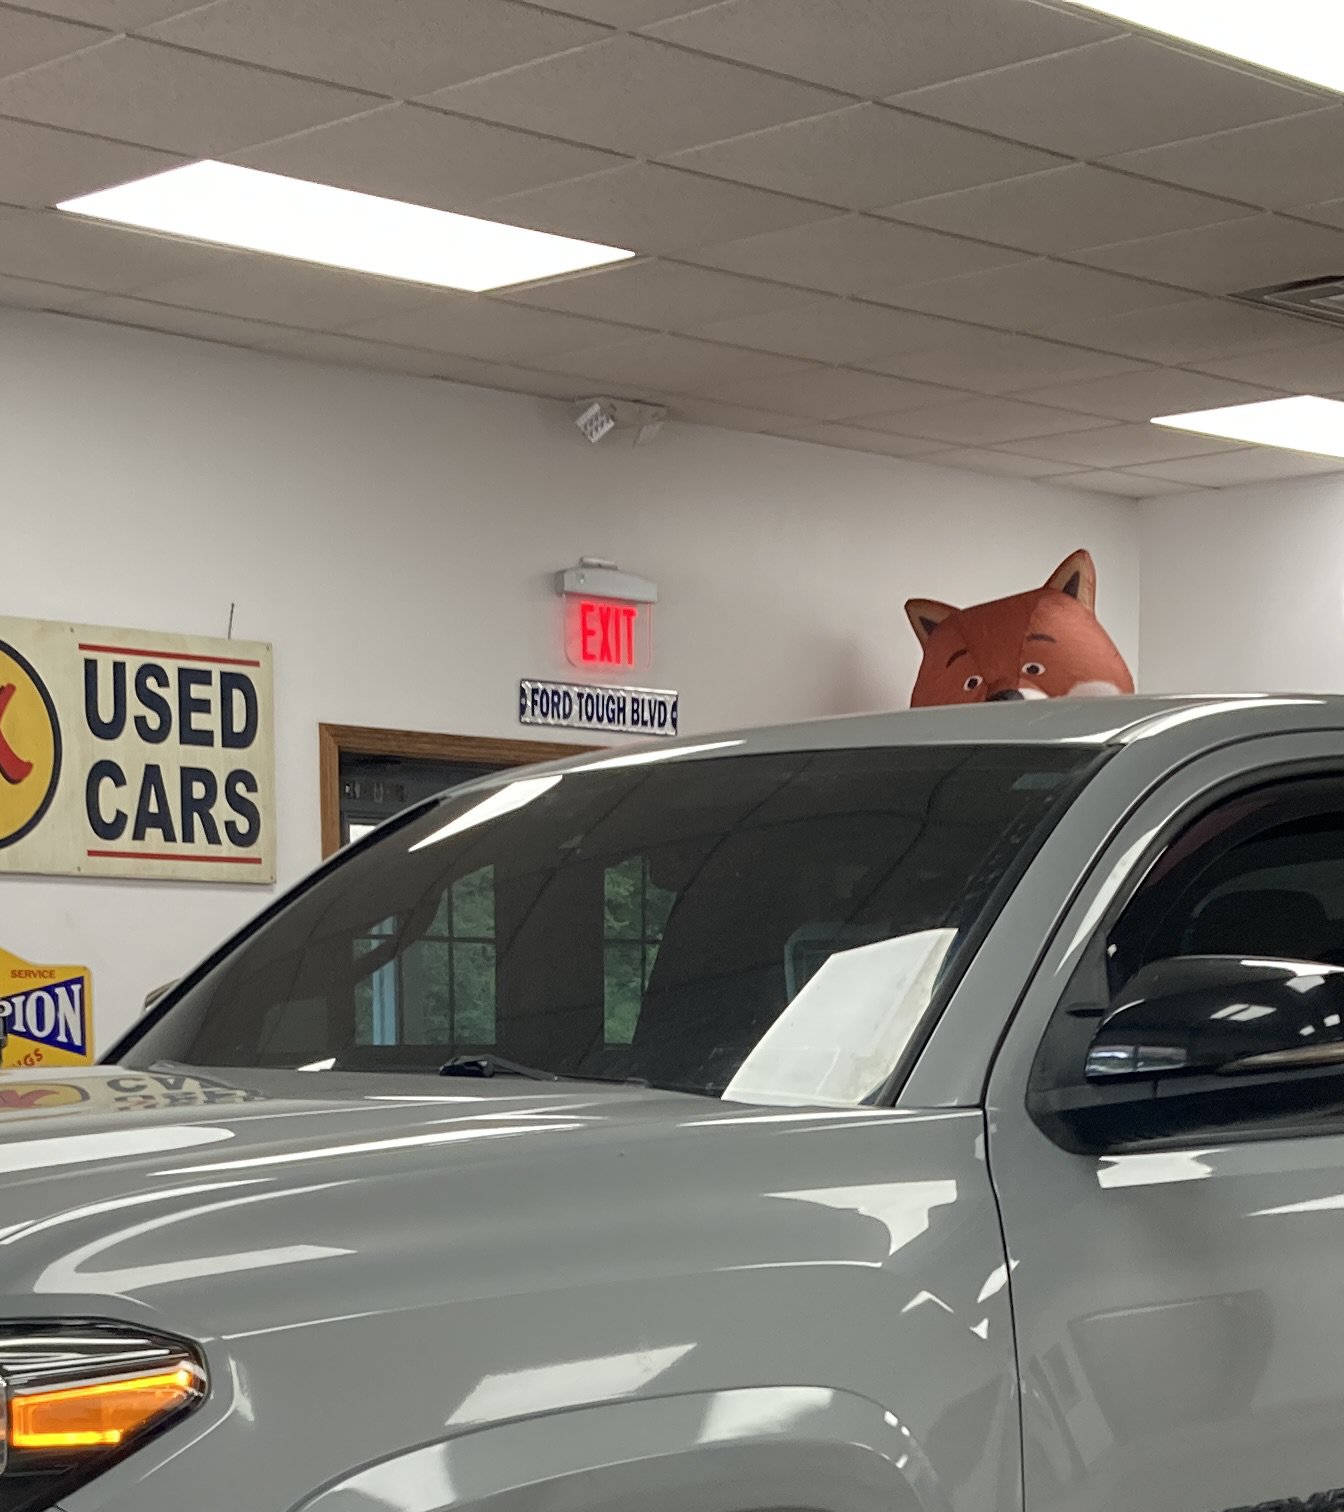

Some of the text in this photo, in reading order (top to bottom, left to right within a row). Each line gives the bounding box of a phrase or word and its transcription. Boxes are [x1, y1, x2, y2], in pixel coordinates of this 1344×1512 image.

[580, 603, 637, 665] EXIT
[83, 658, 258, 750] USED
[531, 687, 668, 728] FORD TOUGH BLVD
[85, 759, 261, 848] CARS
[11, 969, 56, 979] SERVICE
